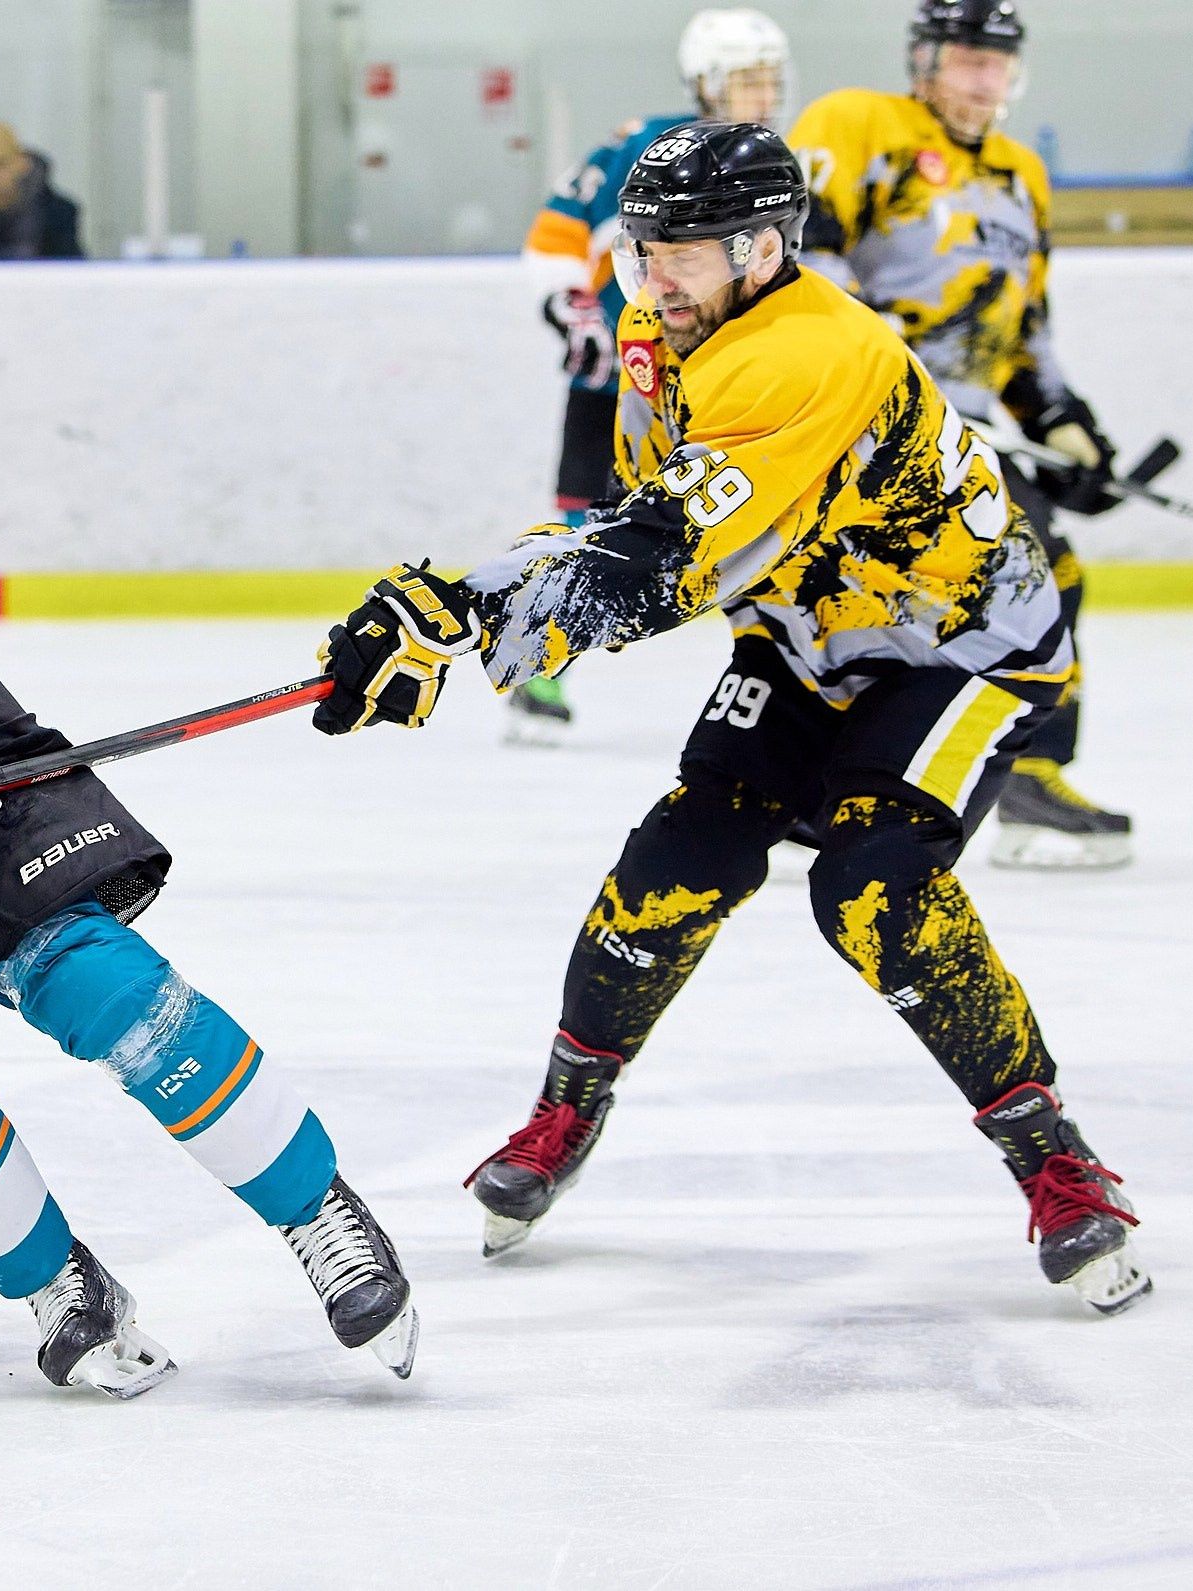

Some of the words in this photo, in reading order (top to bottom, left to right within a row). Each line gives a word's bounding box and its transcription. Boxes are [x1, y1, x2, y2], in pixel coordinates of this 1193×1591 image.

[647, 137, 692, 161] 99
[623, 200, 659, 215] CCM
[754, 192, 792, 207] CCM
[382, 564, 464, 641] UER
[252, 683, 304, 703] HYPERLITE
[705, 674, 773, 729] 99
[19, 821, 121, 886] BAUER
